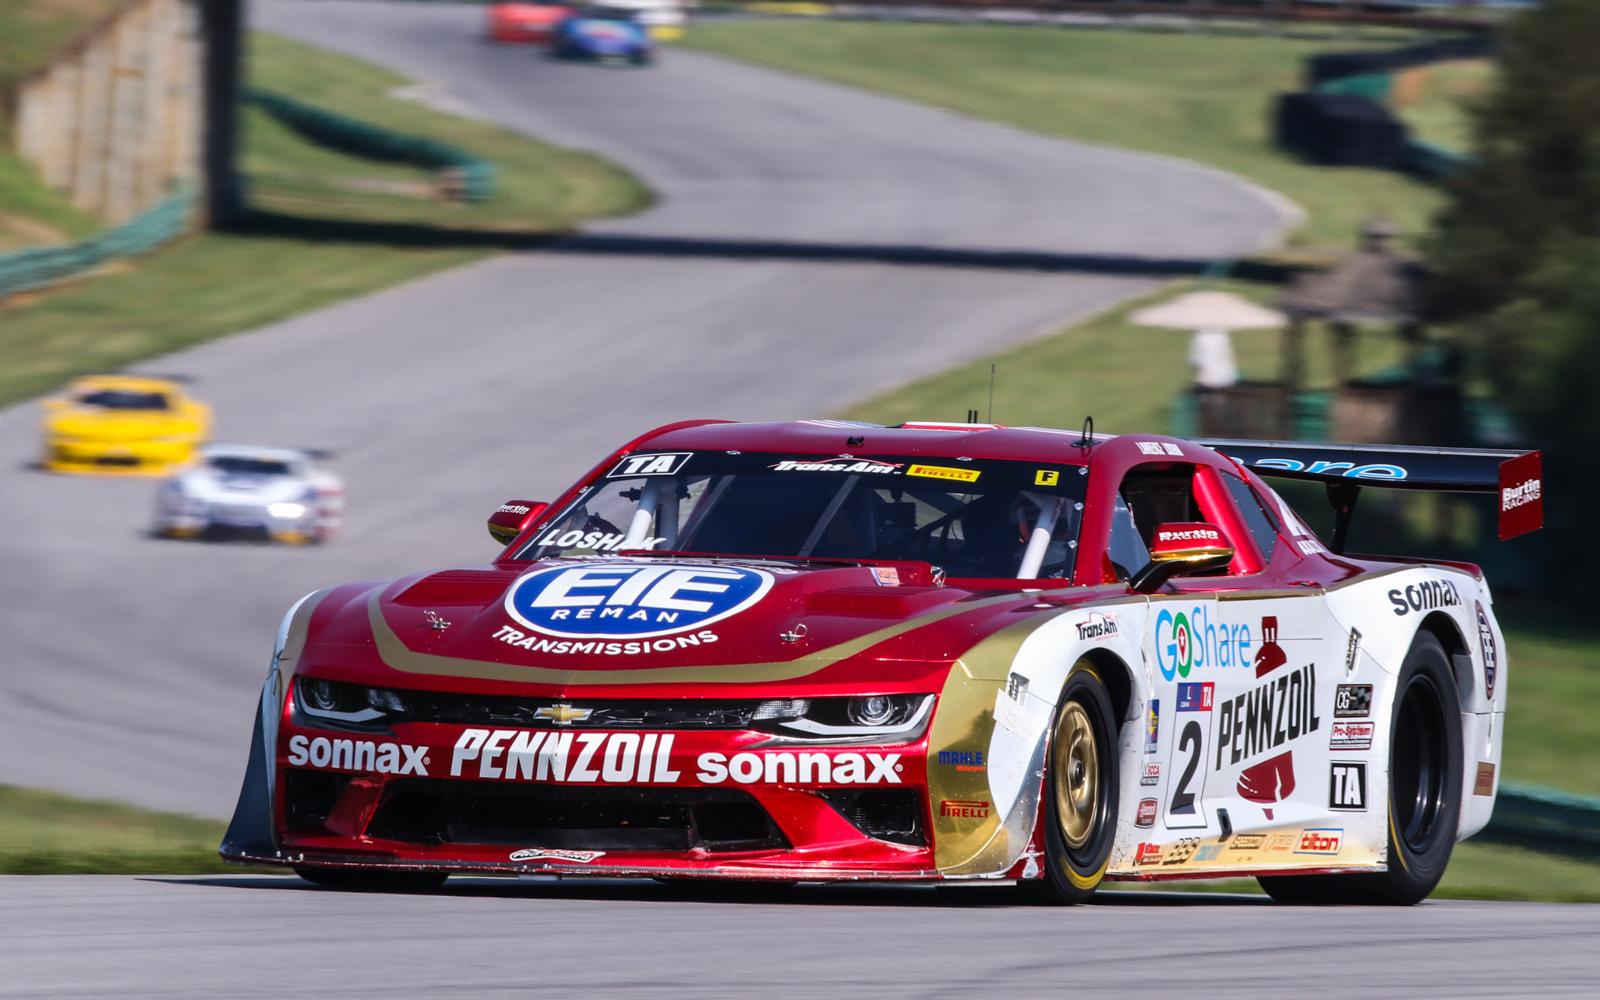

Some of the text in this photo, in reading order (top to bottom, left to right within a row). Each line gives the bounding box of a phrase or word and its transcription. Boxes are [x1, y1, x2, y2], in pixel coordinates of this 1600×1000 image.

[623, 455, 676, 474] TA
[773, 460, 895, 475] Trans Am
[914, 466, 973, 480] PIRELLI
[1041, 471, 1054, 482] F
[1503, 479, 1541, 501] Burtin
[1502, 491, 1541, 511] RACING
[531, 565, 746, 613] EIE
[1388, 579, 1462, 616] sonnax
[550, 607, 680, 624] REMAN
[1075, 616, 1118, 640] Trans Am
[492, 625, 719, 656] TRANSMISSIONS
[1202, 686, 1212, 707] TA
[1215, 662, 1320, 772] PENNZOIL
[288, 728, 902, 785] sonnax PENNZOIL sonnax
[938, 751, 982, 766] MAHLE
[1170, 720, 1202, 815] 2
[1333, 767, 1362, 805] TA
[941, 800, 989, 818] PIRELLI
